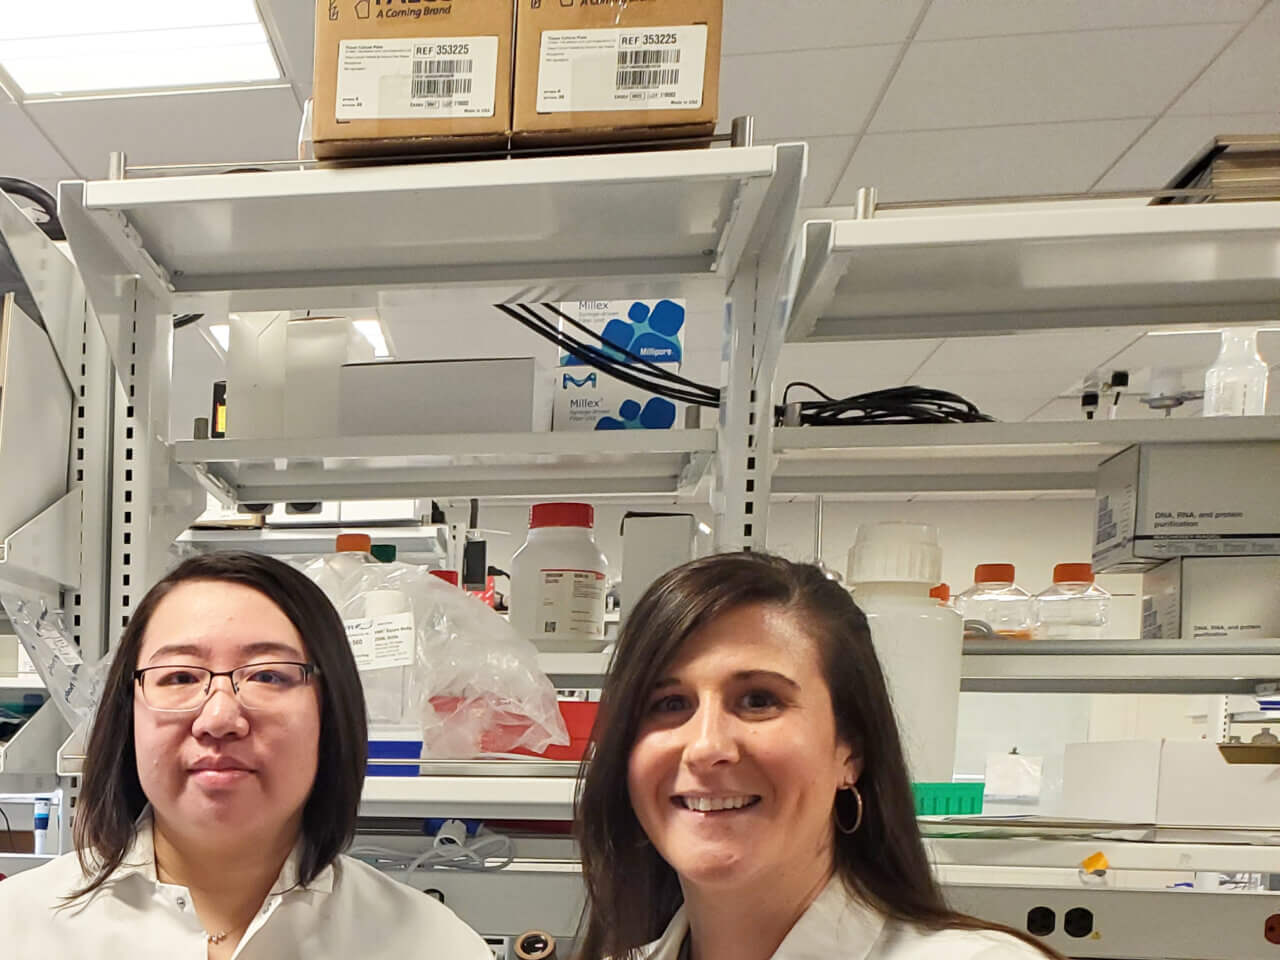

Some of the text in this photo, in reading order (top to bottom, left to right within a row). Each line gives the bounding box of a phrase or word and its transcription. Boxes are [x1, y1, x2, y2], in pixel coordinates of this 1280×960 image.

[376, 4, 452, 19] A Corning Brand
[621, 33, 677, 45] REF 353225
[415, 44, 470, 56] REF 353225
[578, 300, 609, 310] Millex
